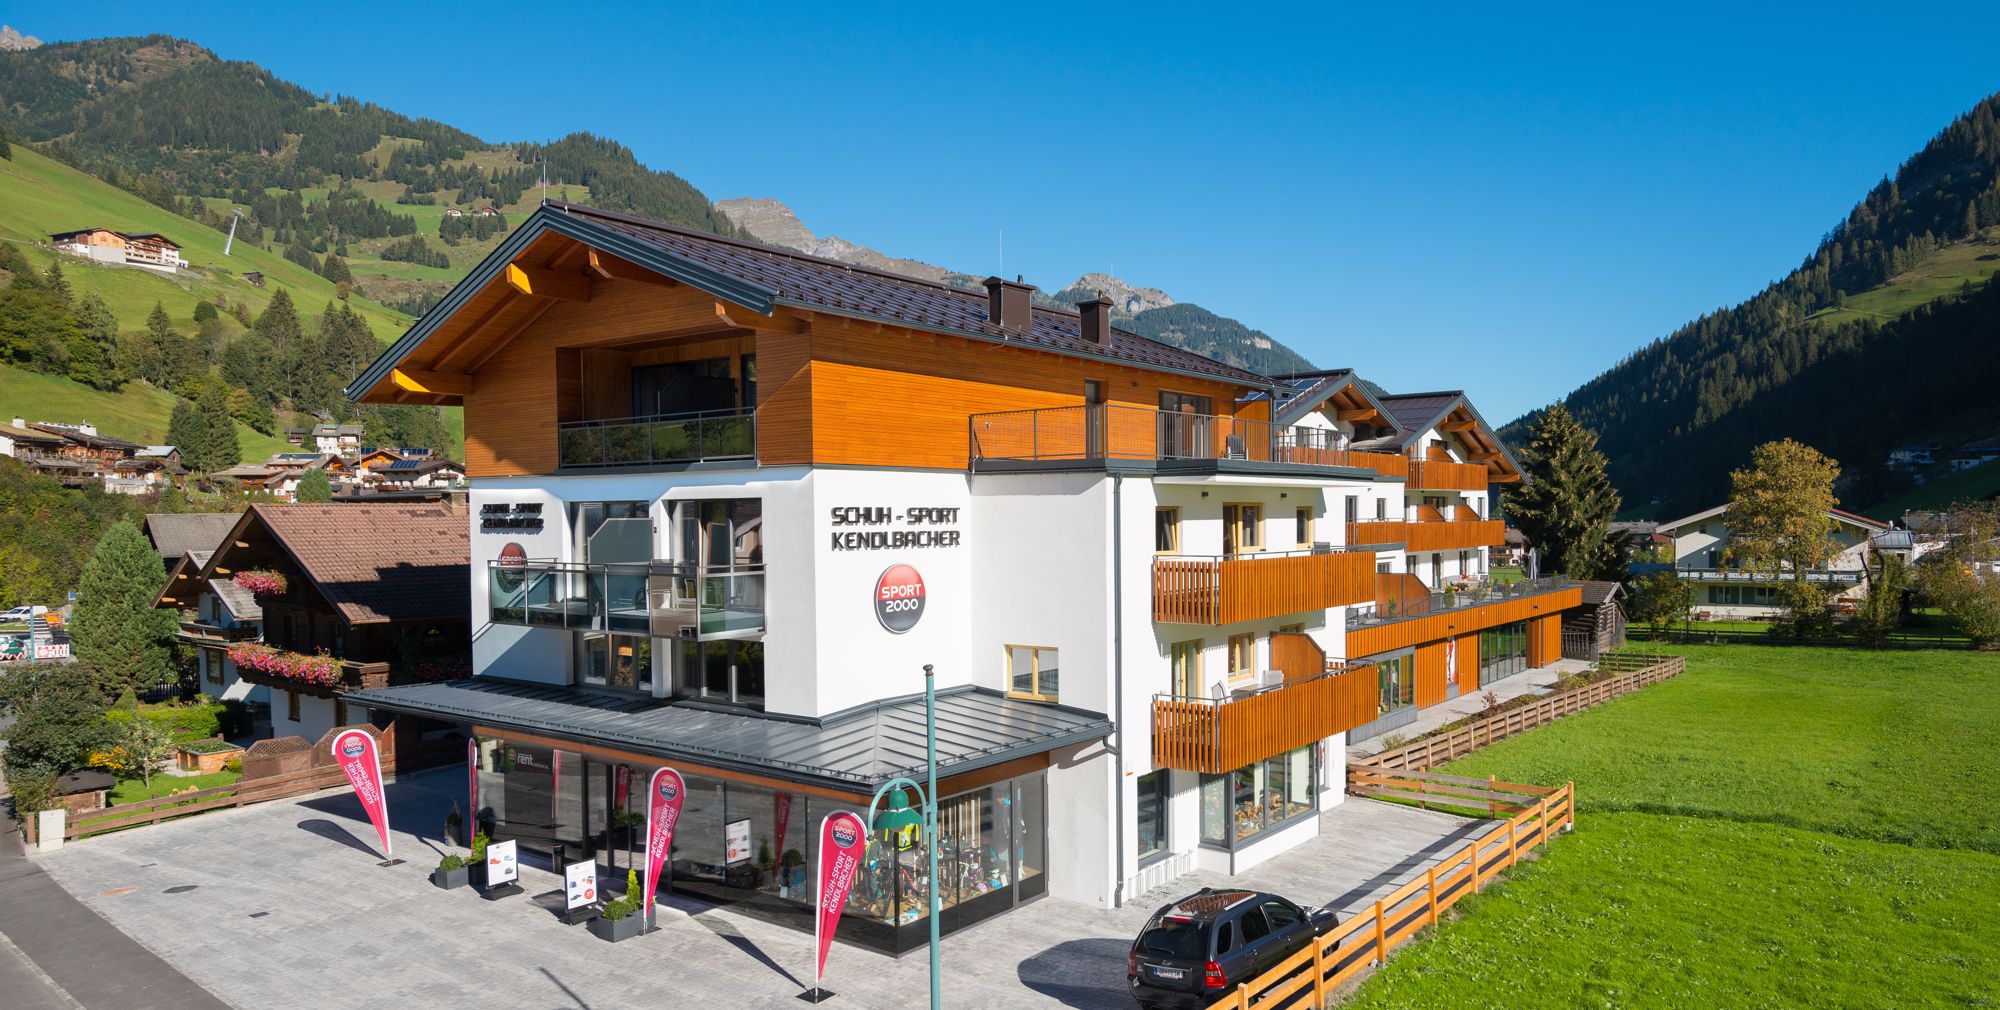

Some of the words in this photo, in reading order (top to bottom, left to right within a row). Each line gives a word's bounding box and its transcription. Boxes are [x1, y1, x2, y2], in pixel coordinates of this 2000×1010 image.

[831, 506, 892, 525] SCHUH
[907, 507, 961, 524] SPORT
[831, 530, 961, 550] KENDLBACHER
[881, 583, 922, 598] SPORT
[885, 598, 919, 612] 2000
[517, 752, 533, 766] rent
[660, 781, 676, 790] SPORT
[661, 787, 675, 795] 2000
[655, 807, 676, 859] KENDLBACHER
[834, 825, 856, 836] SPORT
[835, 831, 853, 841] 2000
[822, 850, 847, 908] SCHUH-SPORT
[828, 855, 854, 914] KENDLBACHER
